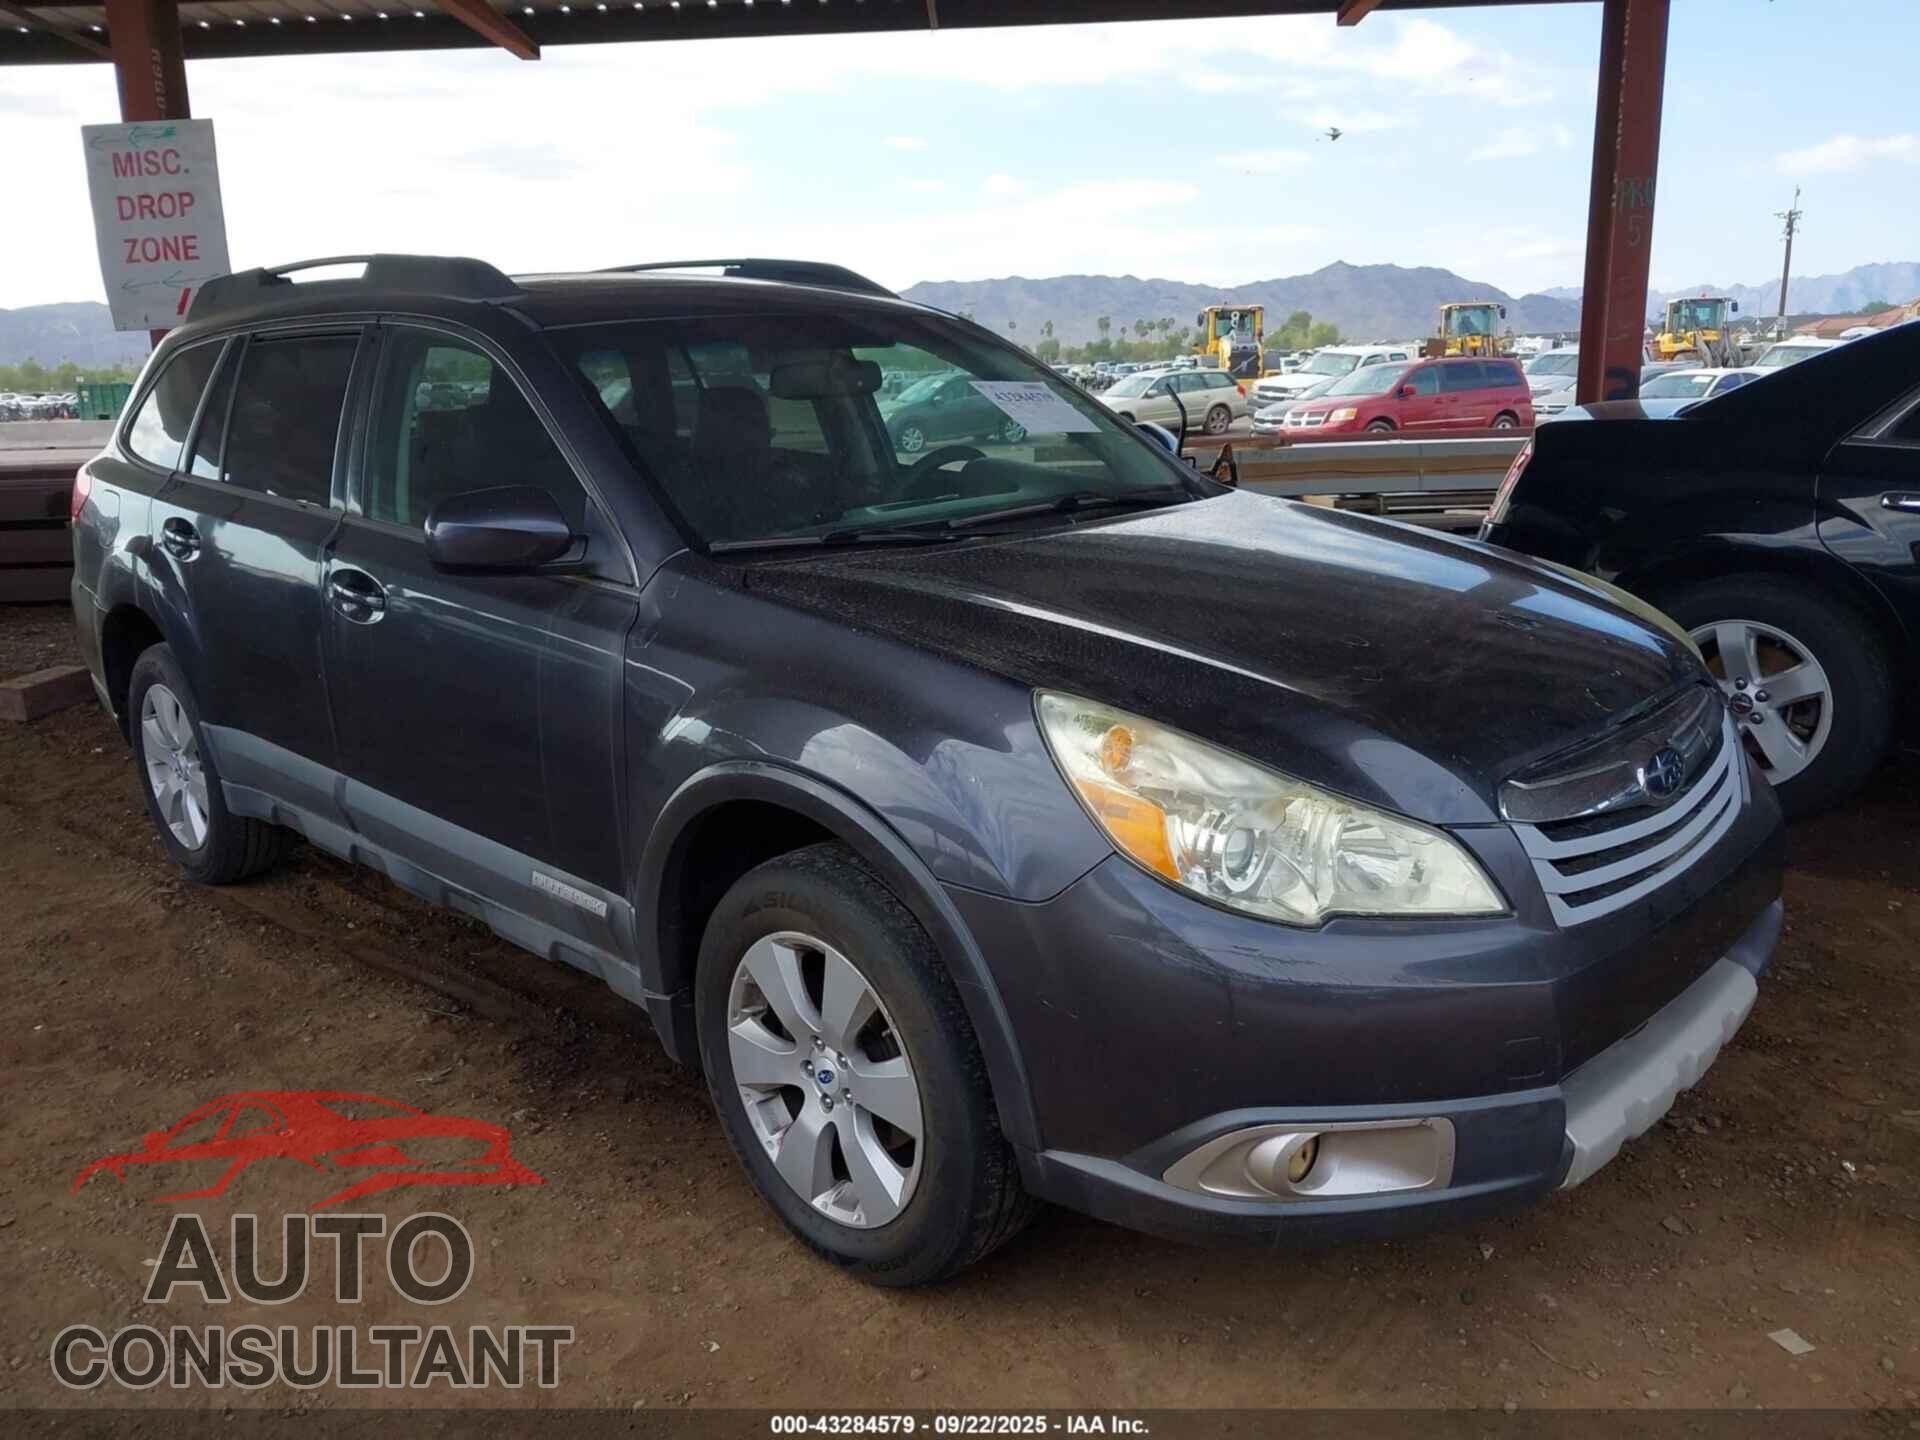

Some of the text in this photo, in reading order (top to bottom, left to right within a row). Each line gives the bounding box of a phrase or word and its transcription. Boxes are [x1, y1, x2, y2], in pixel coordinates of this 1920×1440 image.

[112, 149, 190, 179] MISC.
[117, 193, 195, 221] DROP
[123, 236, 200, 264] ZONE
